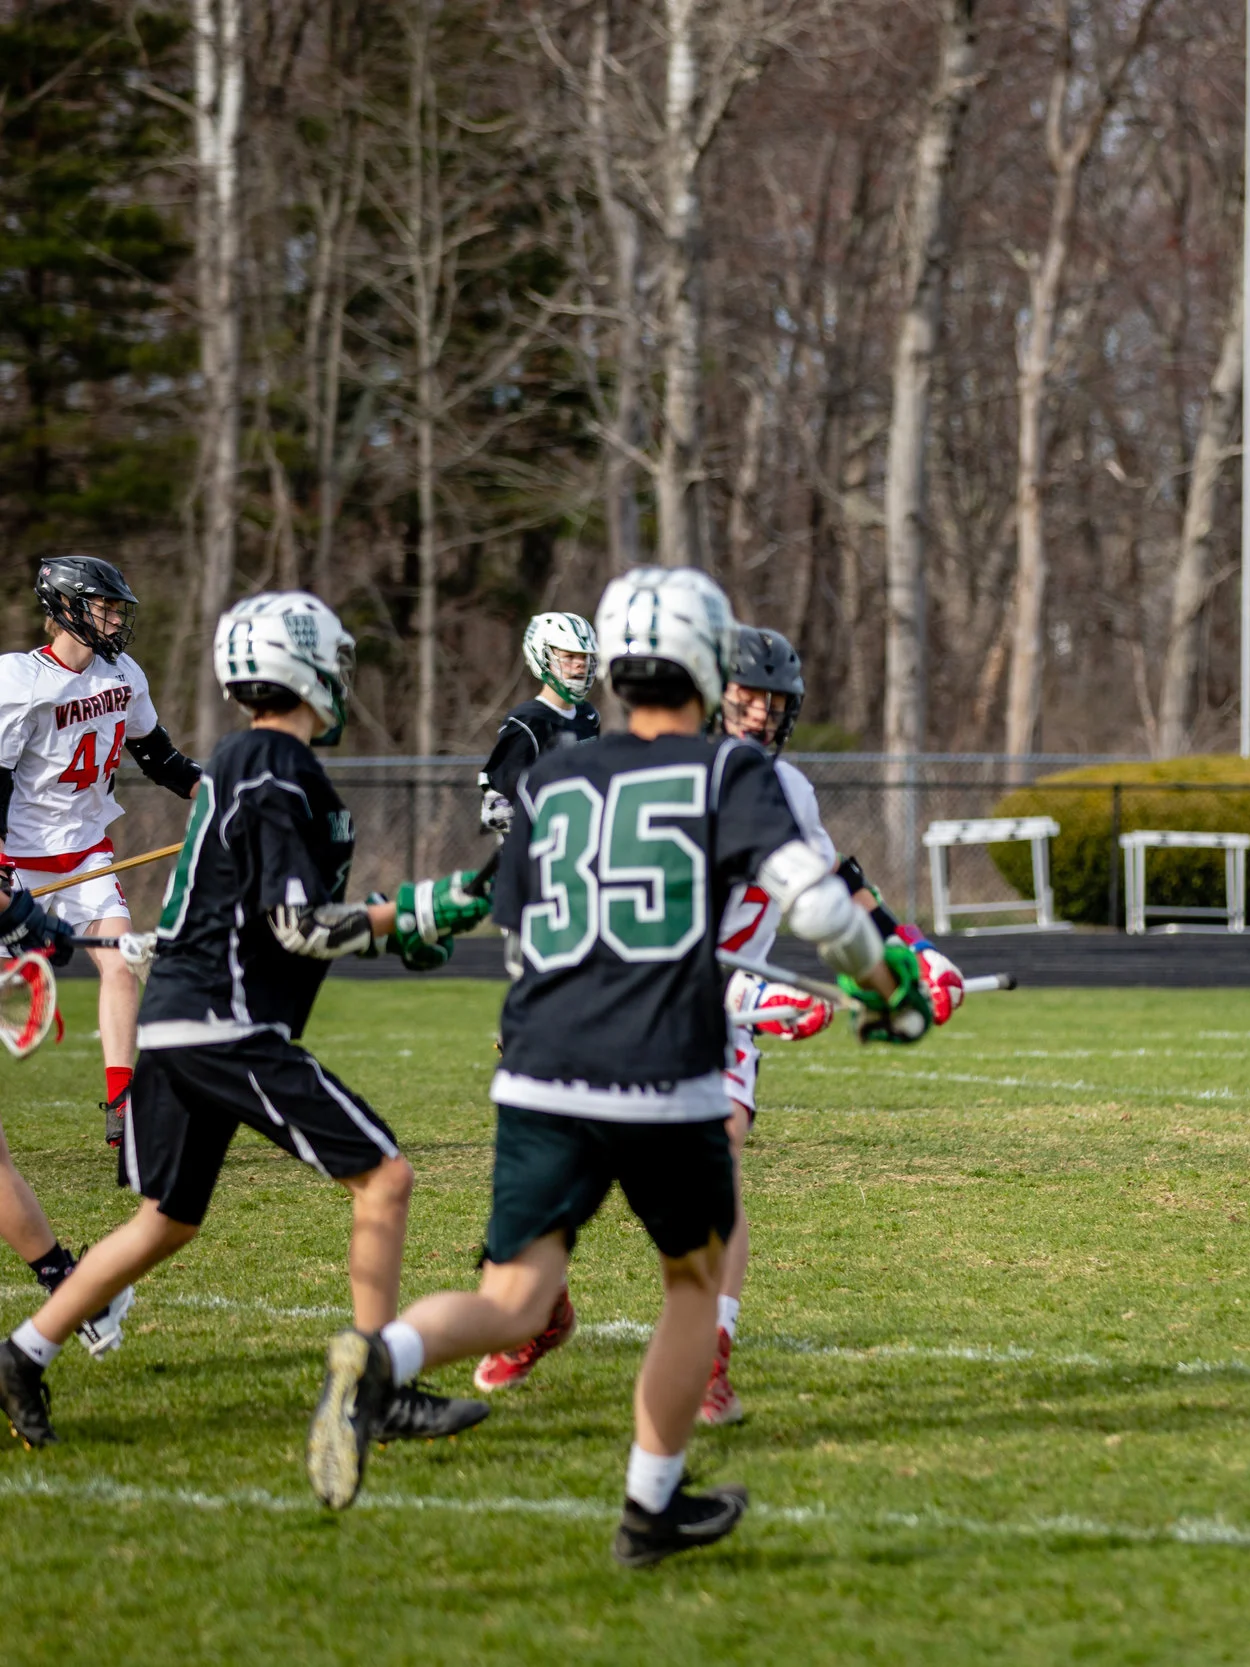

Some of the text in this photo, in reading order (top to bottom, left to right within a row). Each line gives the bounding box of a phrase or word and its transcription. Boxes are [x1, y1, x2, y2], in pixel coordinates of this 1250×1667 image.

[55, 685, 133, 731] WARRIORS
[58, 720, 126, 793] 44
[521, 764, 707, 973] 35
[0, 923, 29, 945] INE
